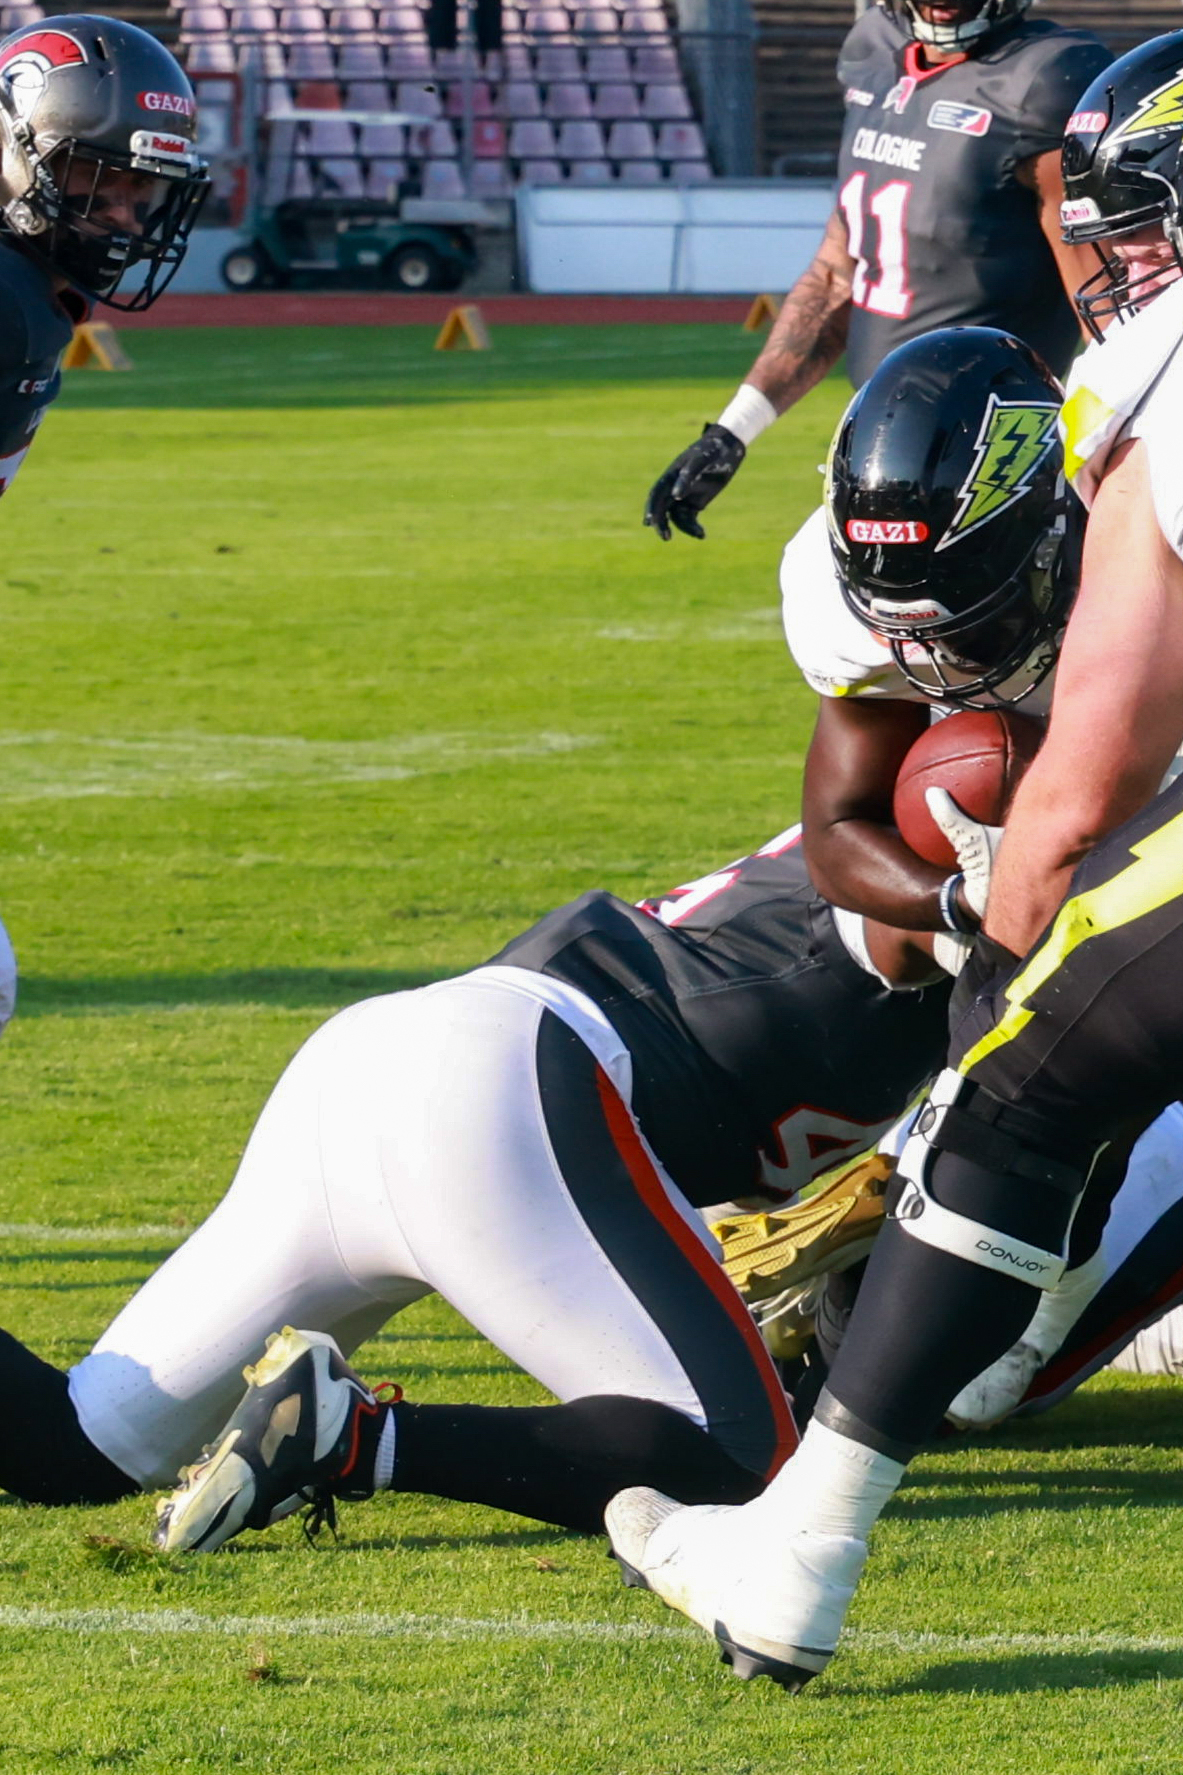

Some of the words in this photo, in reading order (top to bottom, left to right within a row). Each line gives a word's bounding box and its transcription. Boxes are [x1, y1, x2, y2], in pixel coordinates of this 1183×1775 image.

[143, 91, 191, 117] GAZI
[1065, 111, 1101, 135] AZI
[852, 127, 927, 172] COLOGNE
[840, 171, 914, 319] 11
[850, 520, 921, 543] GAZI
[974, 1239, 1050, 1274] DONJOY
